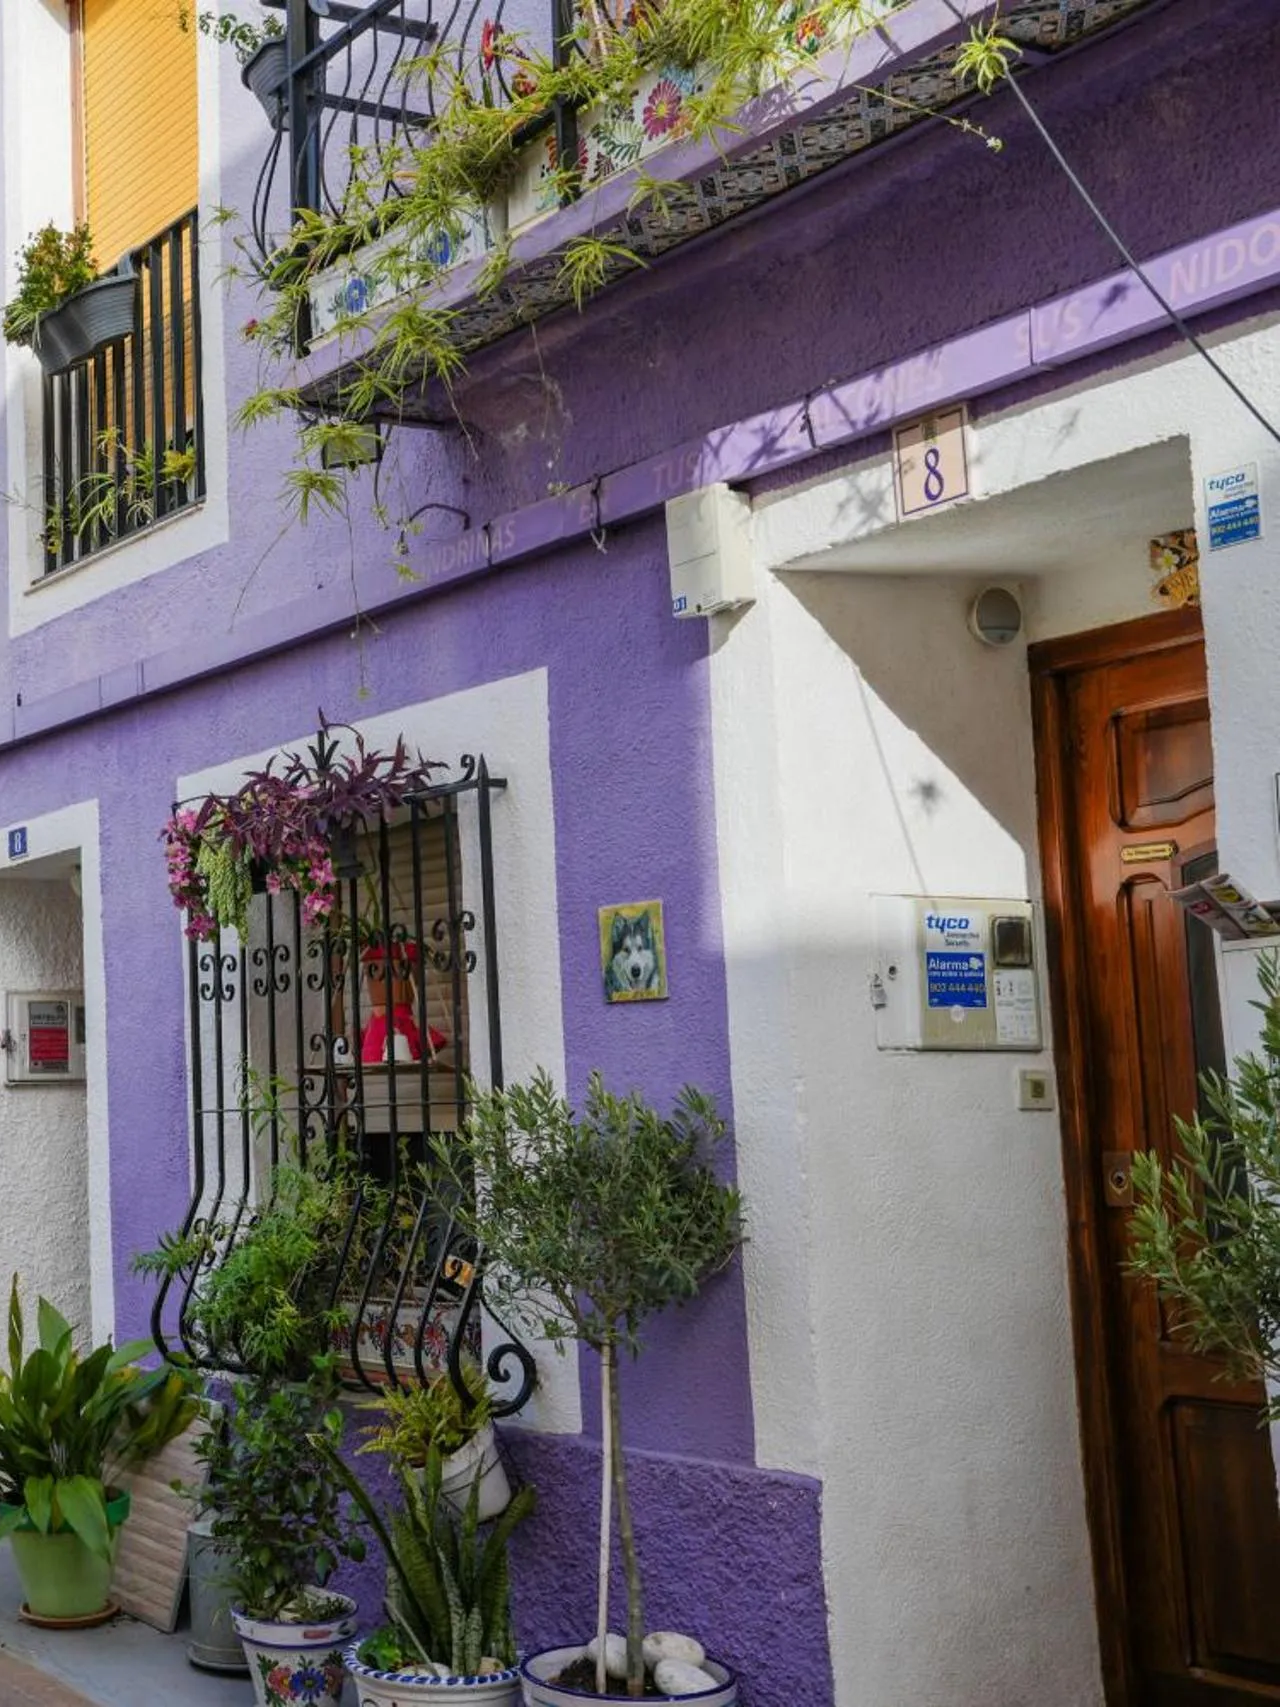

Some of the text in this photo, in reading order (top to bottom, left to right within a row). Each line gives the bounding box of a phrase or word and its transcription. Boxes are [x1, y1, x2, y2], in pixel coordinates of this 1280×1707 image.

[1014, 301, 1081, 358] SUS
[923, 447, 945, 502] 8
[1207, 473, 1245, 490] tyco
[926, 915, 970, 934] tyco
[928, 957, 969, 970] Alarma
